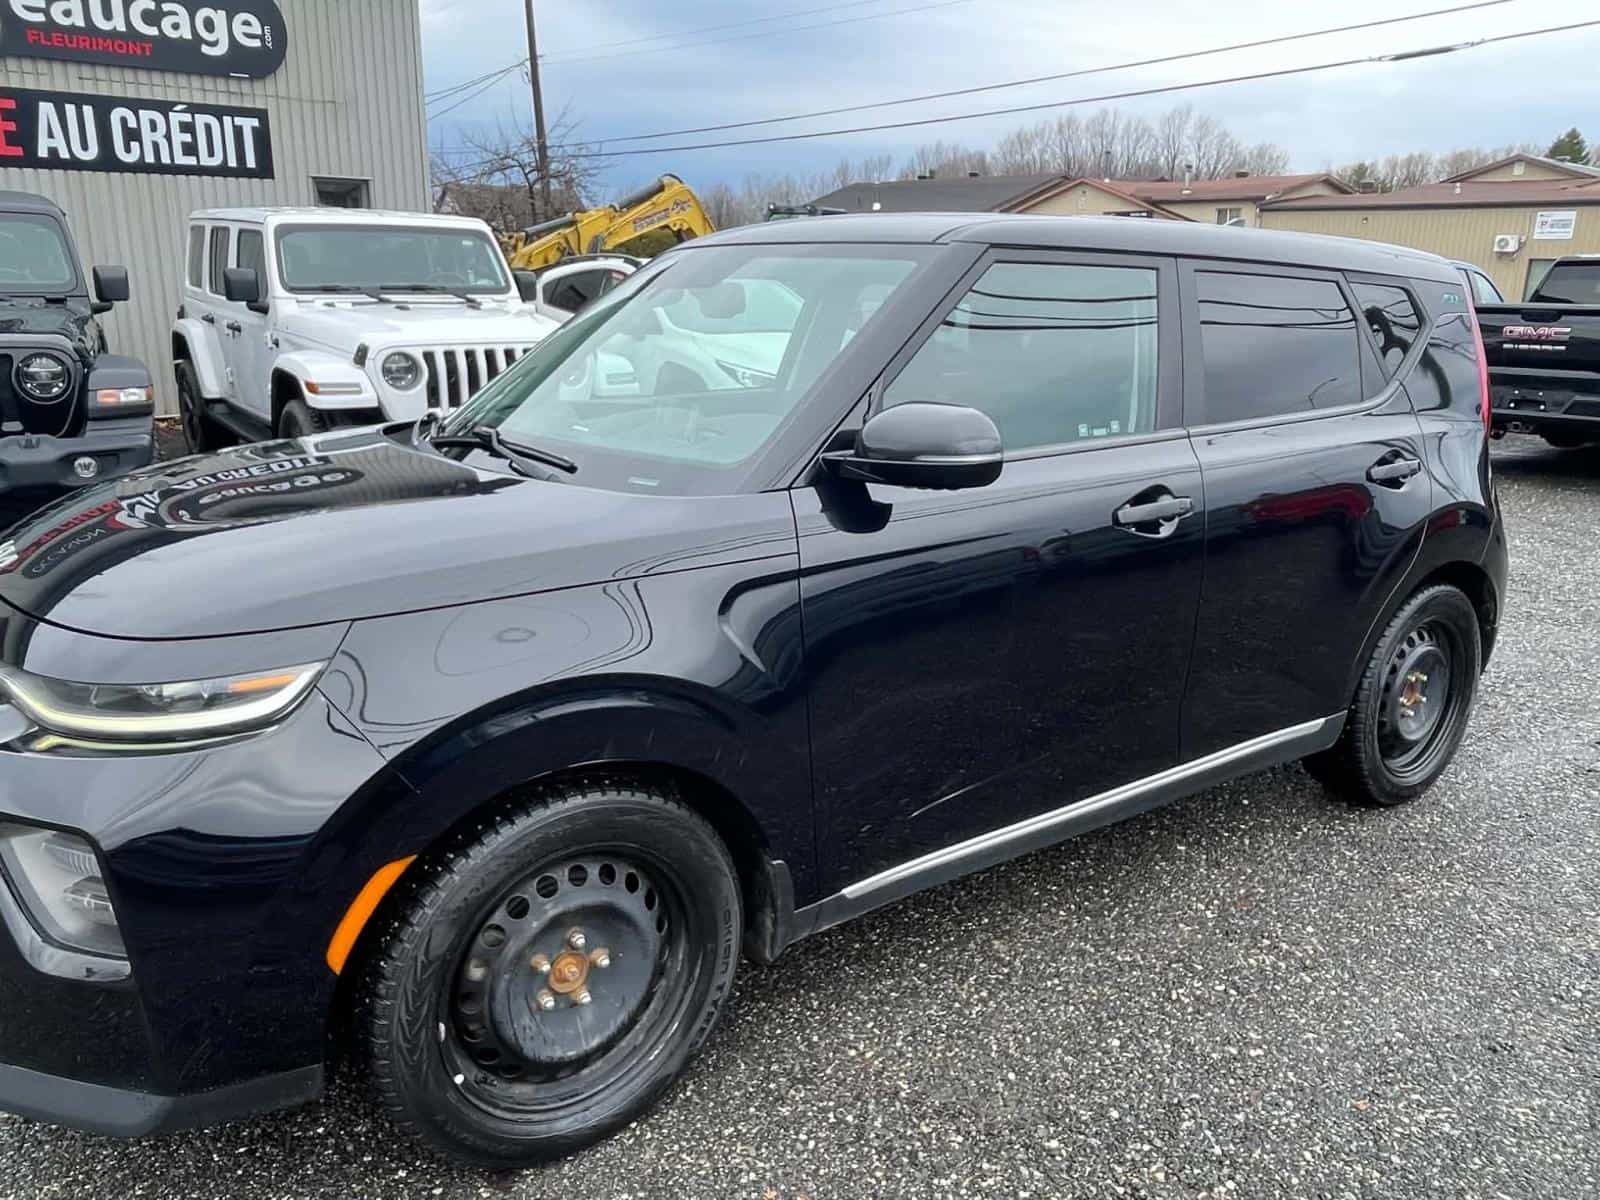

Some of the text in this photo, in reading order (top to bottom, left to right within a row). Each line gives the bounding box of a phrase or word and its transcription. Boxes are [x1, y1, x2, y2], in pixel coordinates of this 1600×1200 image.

[26, 28, 153, 57] FLEURIMONT
[264, 25, 272, 50] .com
[37, 101, 99, 161] AU
[110, 104, 259, 169] CRÉDIT
[1503, 326, 1571, 339] GMC
